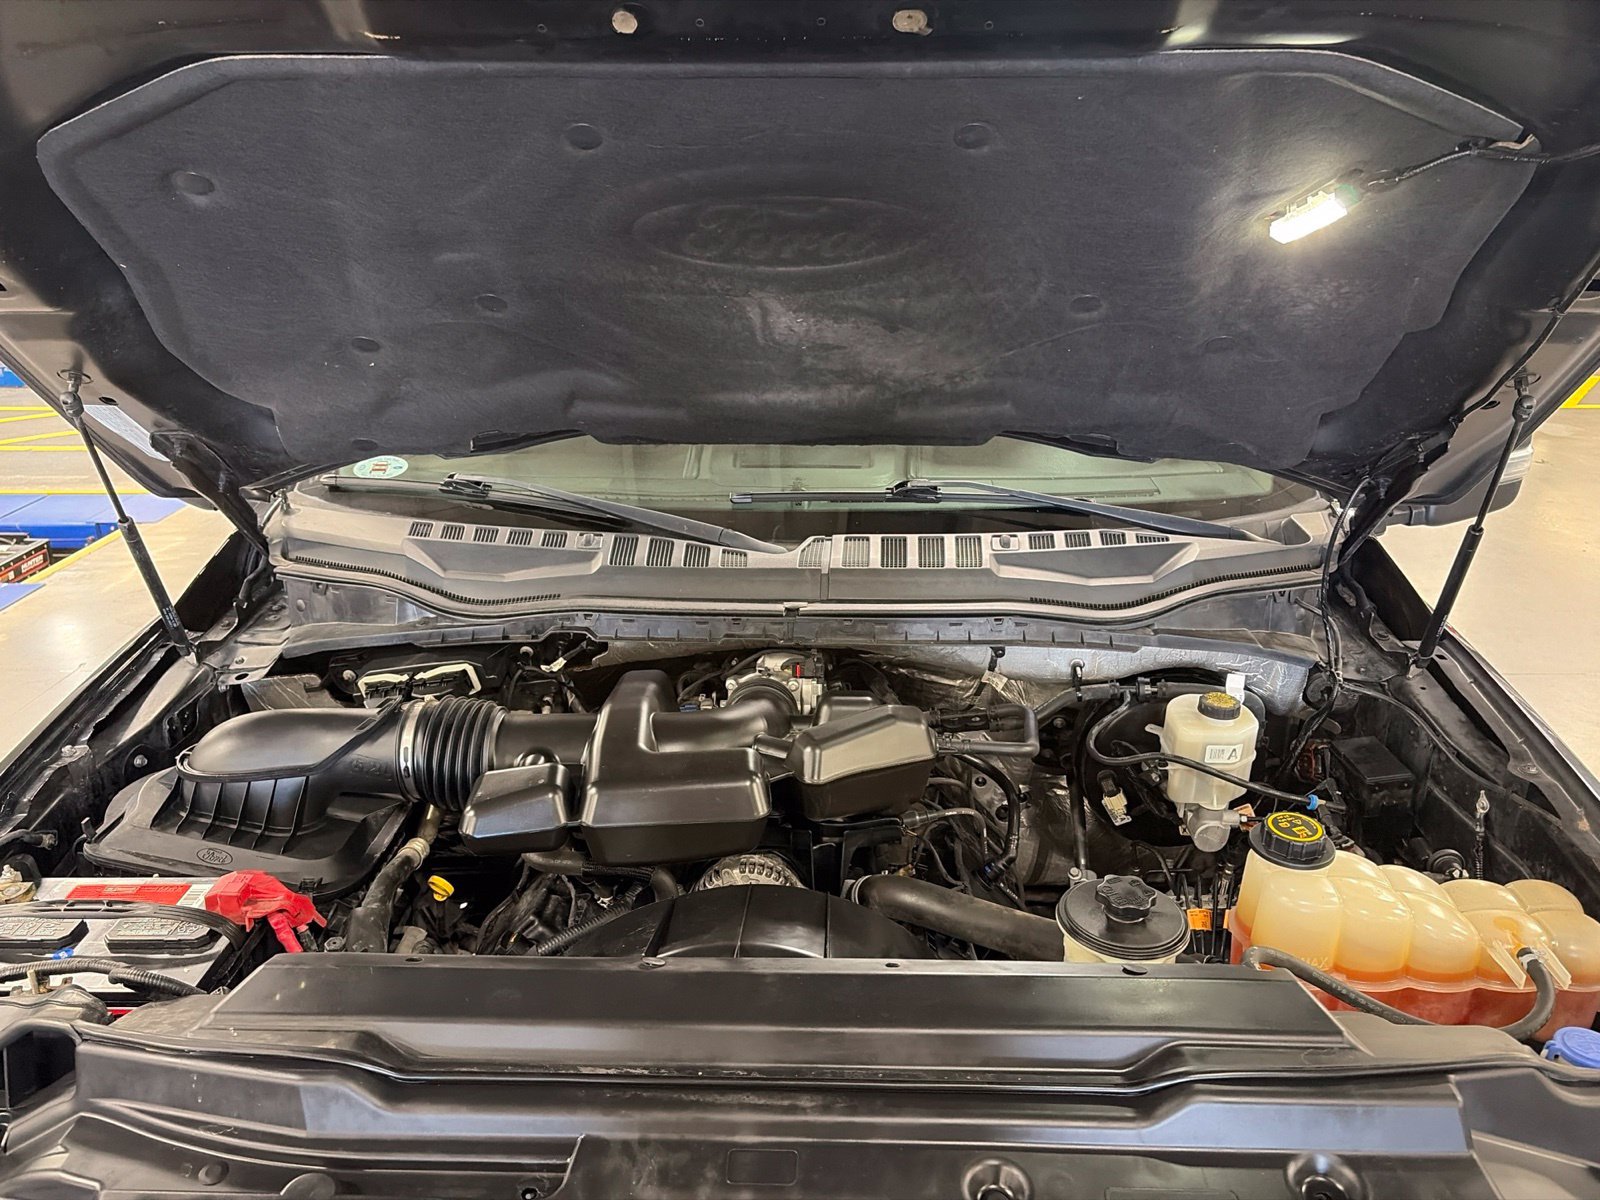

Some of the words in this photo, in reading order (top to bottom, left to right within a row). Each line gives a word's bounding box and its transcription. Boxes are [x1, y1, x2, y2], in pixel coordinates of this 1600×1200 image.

[21, 554, 44, 573] HUNTER
[1226, 748, 1238, 760] A
[202, 847, 228, 863] Ford
